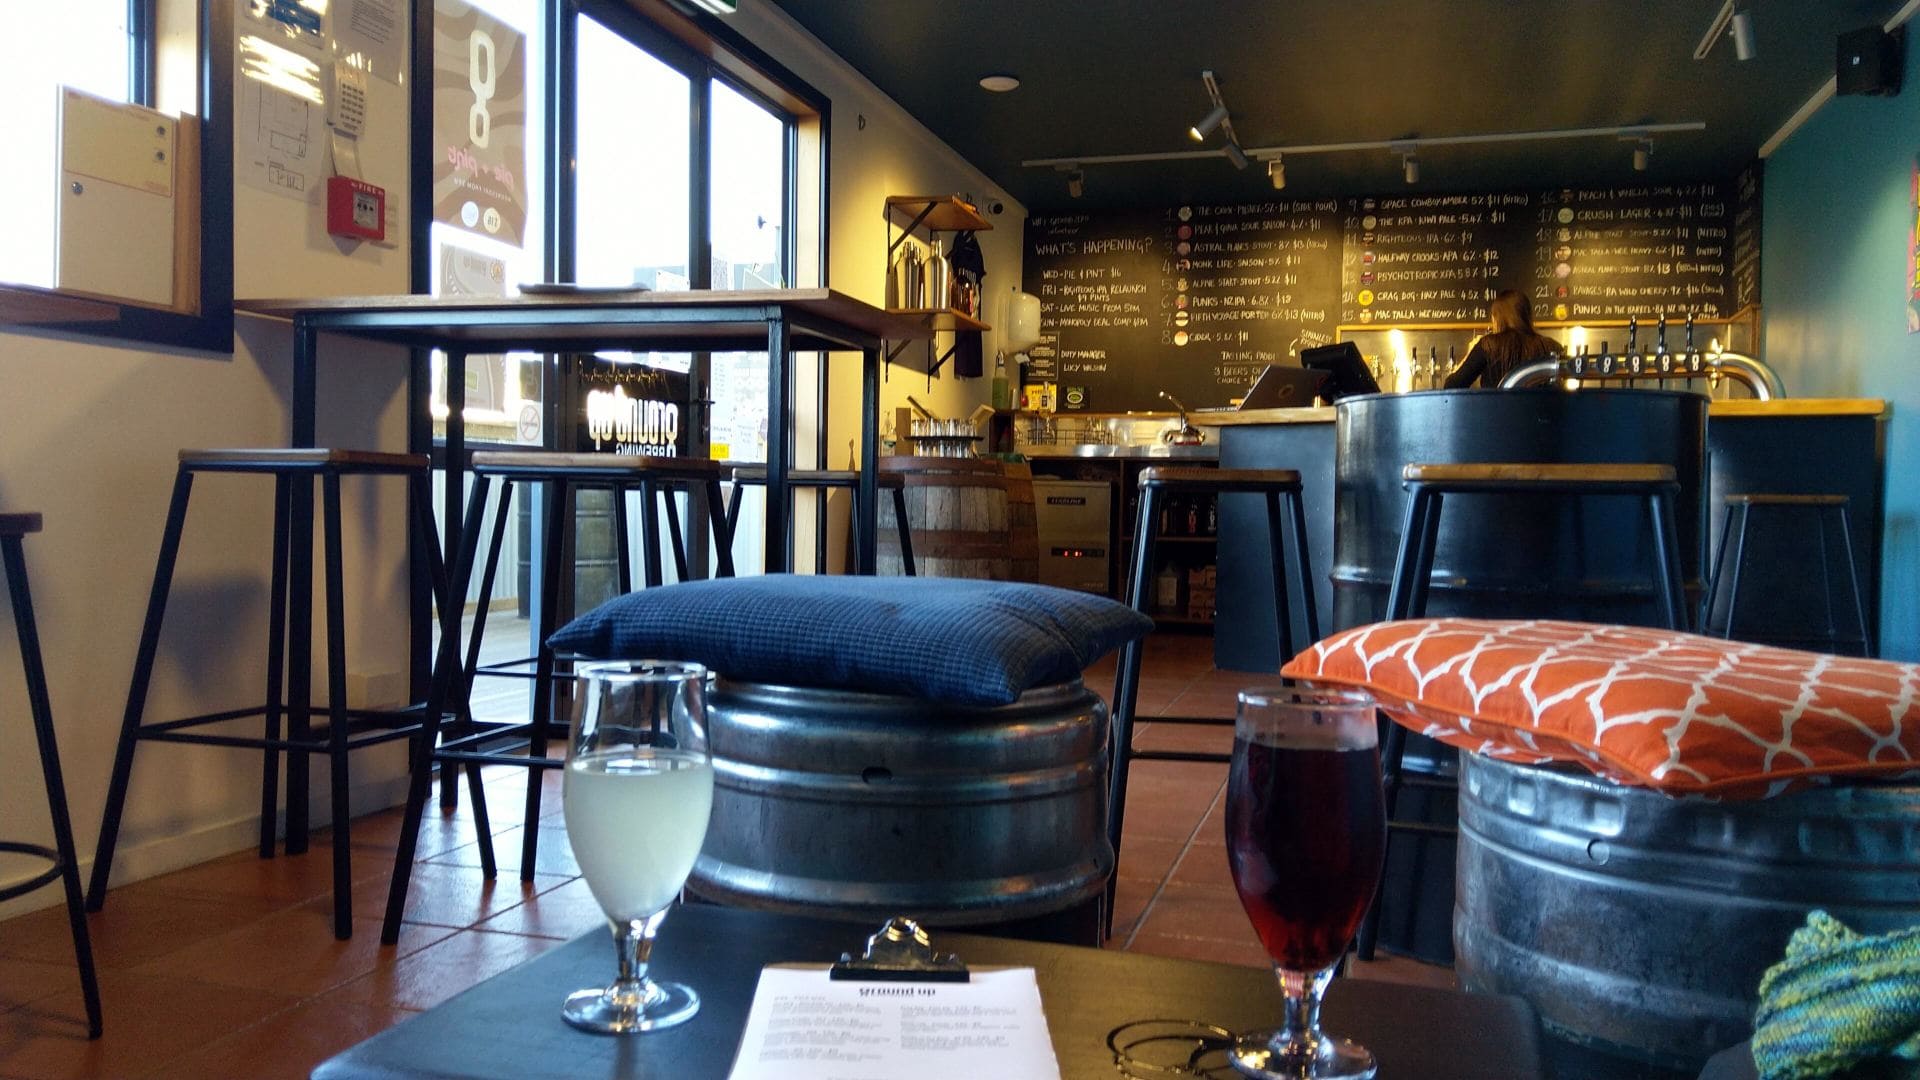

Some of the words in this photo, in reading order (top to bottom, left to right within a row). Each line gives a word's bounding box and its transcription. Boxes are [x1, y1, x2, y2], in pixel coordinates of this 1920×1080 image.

[358, 183, 377, 194] FIRE
[1380, 200, 1407, 209] SPACE
[1491, 209, 1506, 224] $11
[1577, 209, 1614, 221] CRUSH
[1620, 208, 1651, 220] LAGER
[1377, 234, 1422, 244] RIGHTEOUS
[1426, 233, 1439, 244] IPA
[1697, 227, 1727, 240] (NITRO)
[1035, 241, 1077, 256] WHAT'S
[1083, 237, 1152, 254] HAPPENING?
[1192, 260, 1213, 269] MONK
[1216, 260, 1233, 268] LIFE
[1238, 258, 1264, 268] SAISON
[1286, 254, 1301, 267] $11
[1378, 252, 1410, 264] HALFWAY
[1411, 251, 1440, 262] CROOKS
[1462, 250, 1476, 262] 6%
[1483, 248, 1499, 264] $12
[1377, 270, 1439, 282] PSYCHOTROPIC
[1483, 265, 1499, 280] $12
[1285, 273, 1297, 286] $11
[1042, 285, 1057, 295] FRI
[1111, 284, 1147, 295] RELAUNCH
[1377, 291, 1399, 302] CRAG
[1401, 291, 1416, 303] DOG
[1484, 287, 1497, 302] $11
[1192, 296, 1218, 307] PUNKS
[1040, 303, 1054, 312] SAT
[1060, 304, 1076, 312] LIVE
[1079, 303, 1100, 312] MUSIC
[1103, 303, 1121, 312] FROM
[1573, 304, 1601, 315] PUNKS
[1271, 310, 1283, 320] 6%
[1285, 309, 1298, 320] $13
[1375, 309, 1391, 321] MAC
[1392, 310, 1415, 320] TALLA
[1474, 306, 1487, 321] $12
[1061, 350, 1077, 358] DUTY
[1221, 350, 1252, 361] TASTING
[1223, 366, 1248, 376] BEERS
